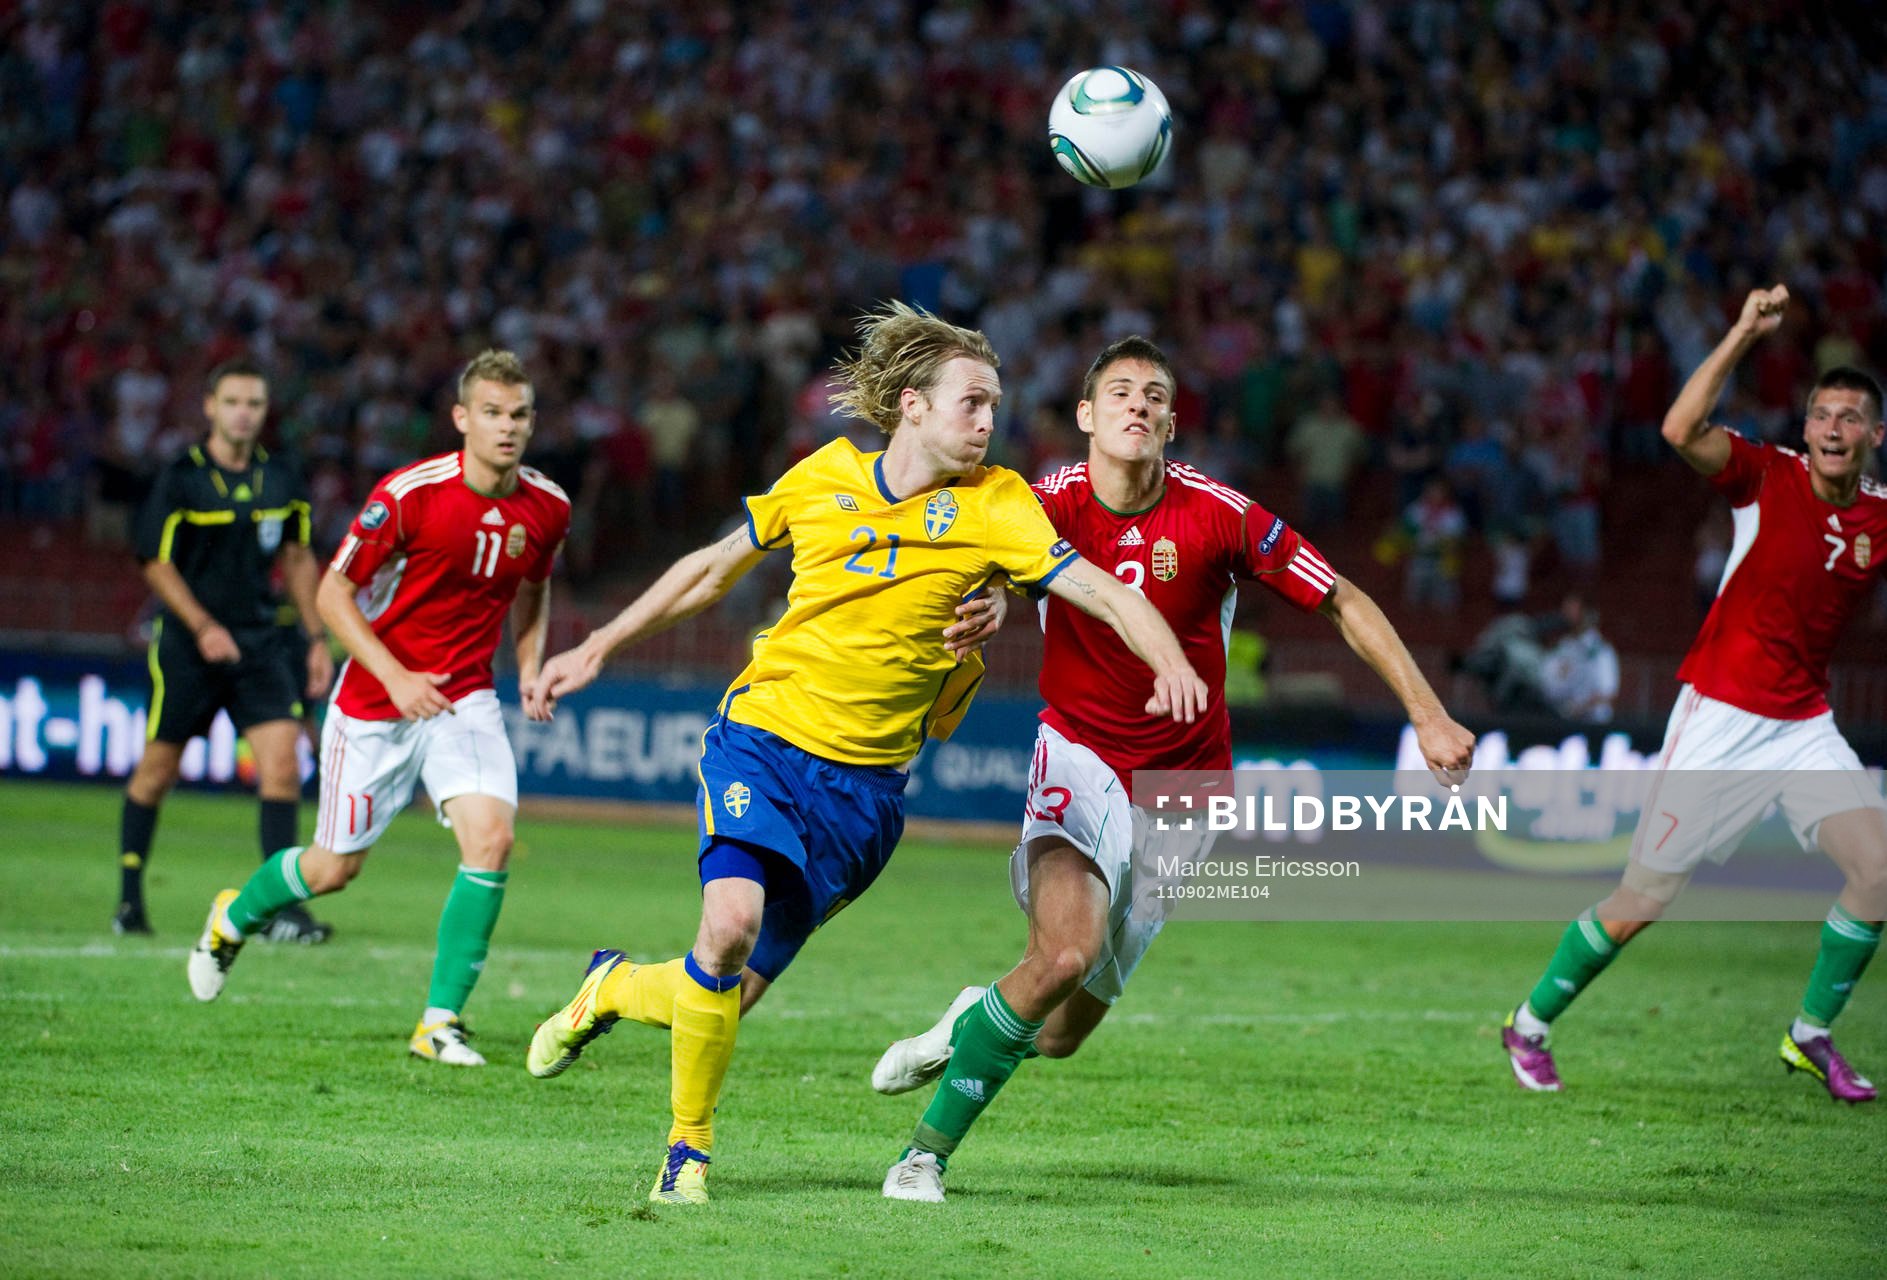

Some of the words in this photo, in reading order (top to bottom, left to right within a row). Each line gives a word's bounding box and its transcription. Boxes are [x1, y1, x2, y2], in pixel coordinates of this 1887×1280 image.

[1117, 538, 1146, 547] adidas
[1266, 518, 1284, 544] RESPECT
[472, 530, 503, 578] 11
[844, 525, 901, 579] 21
[1823, 533, 1847, 572] 7
[1115, 560, 1146, 597] 3
[347, 793, 374, 836] 11
[1035, 786, 1072, 827] 3
[1655, 811, 1679, 852] 7
[951, 1079, 985, 1103] adidas
